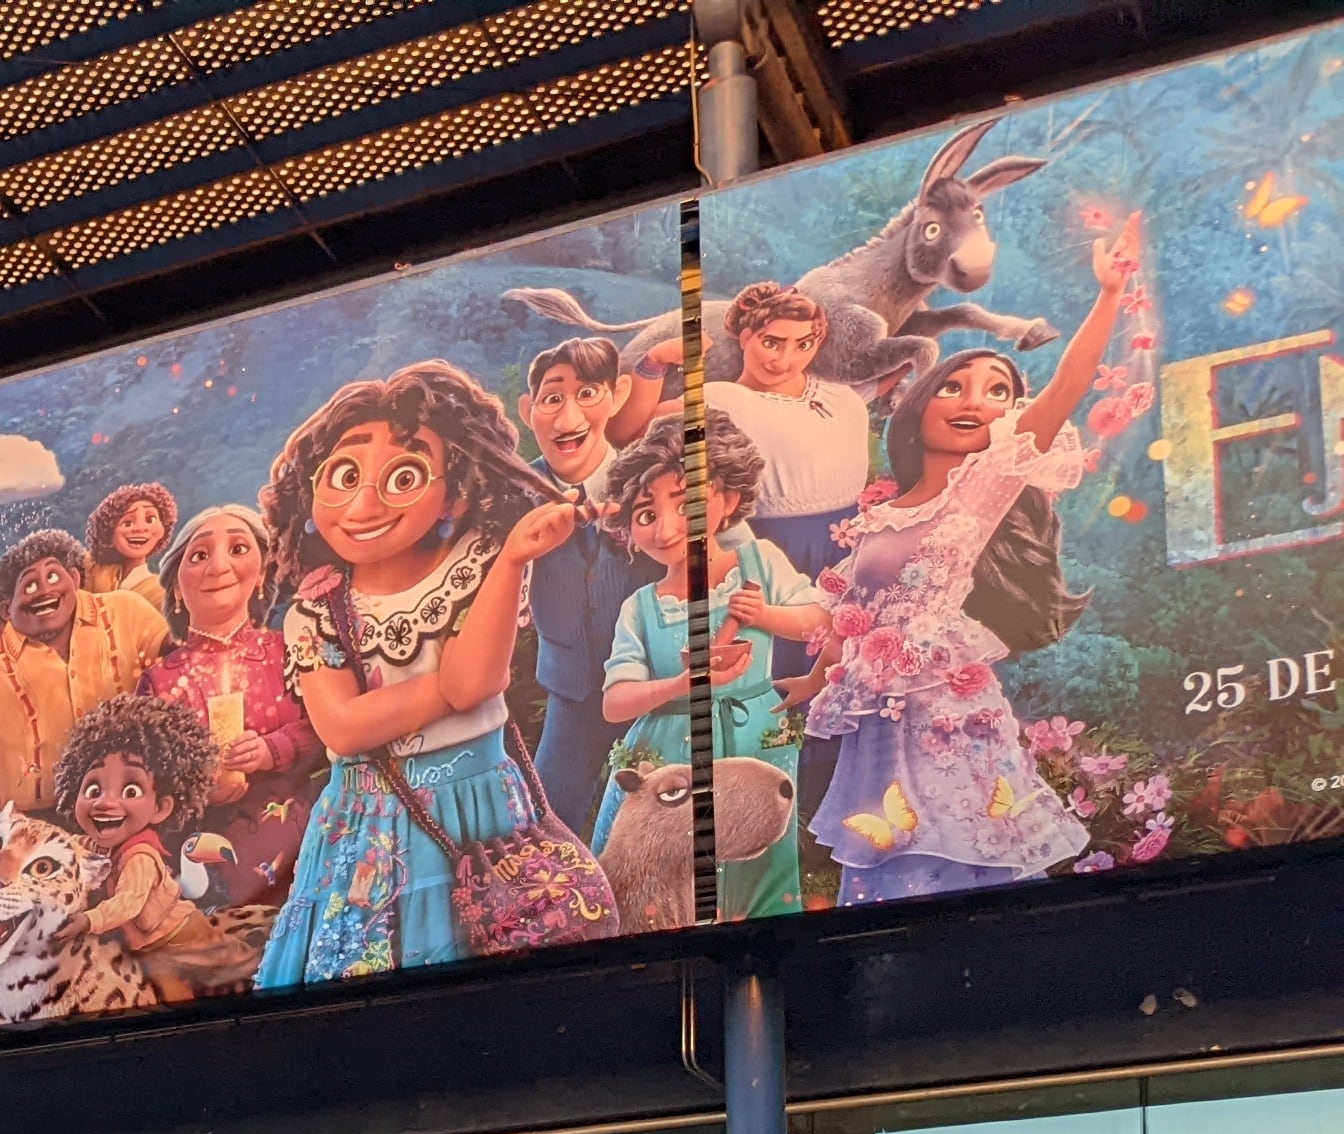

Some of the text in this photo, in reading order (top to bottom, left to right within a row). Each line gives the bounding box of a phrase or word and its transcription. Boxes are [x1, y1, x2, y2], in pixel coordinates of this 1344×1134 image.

[1161, 330, 1344, 569] E
[1183, 649, 1336, 715] 25 DE
